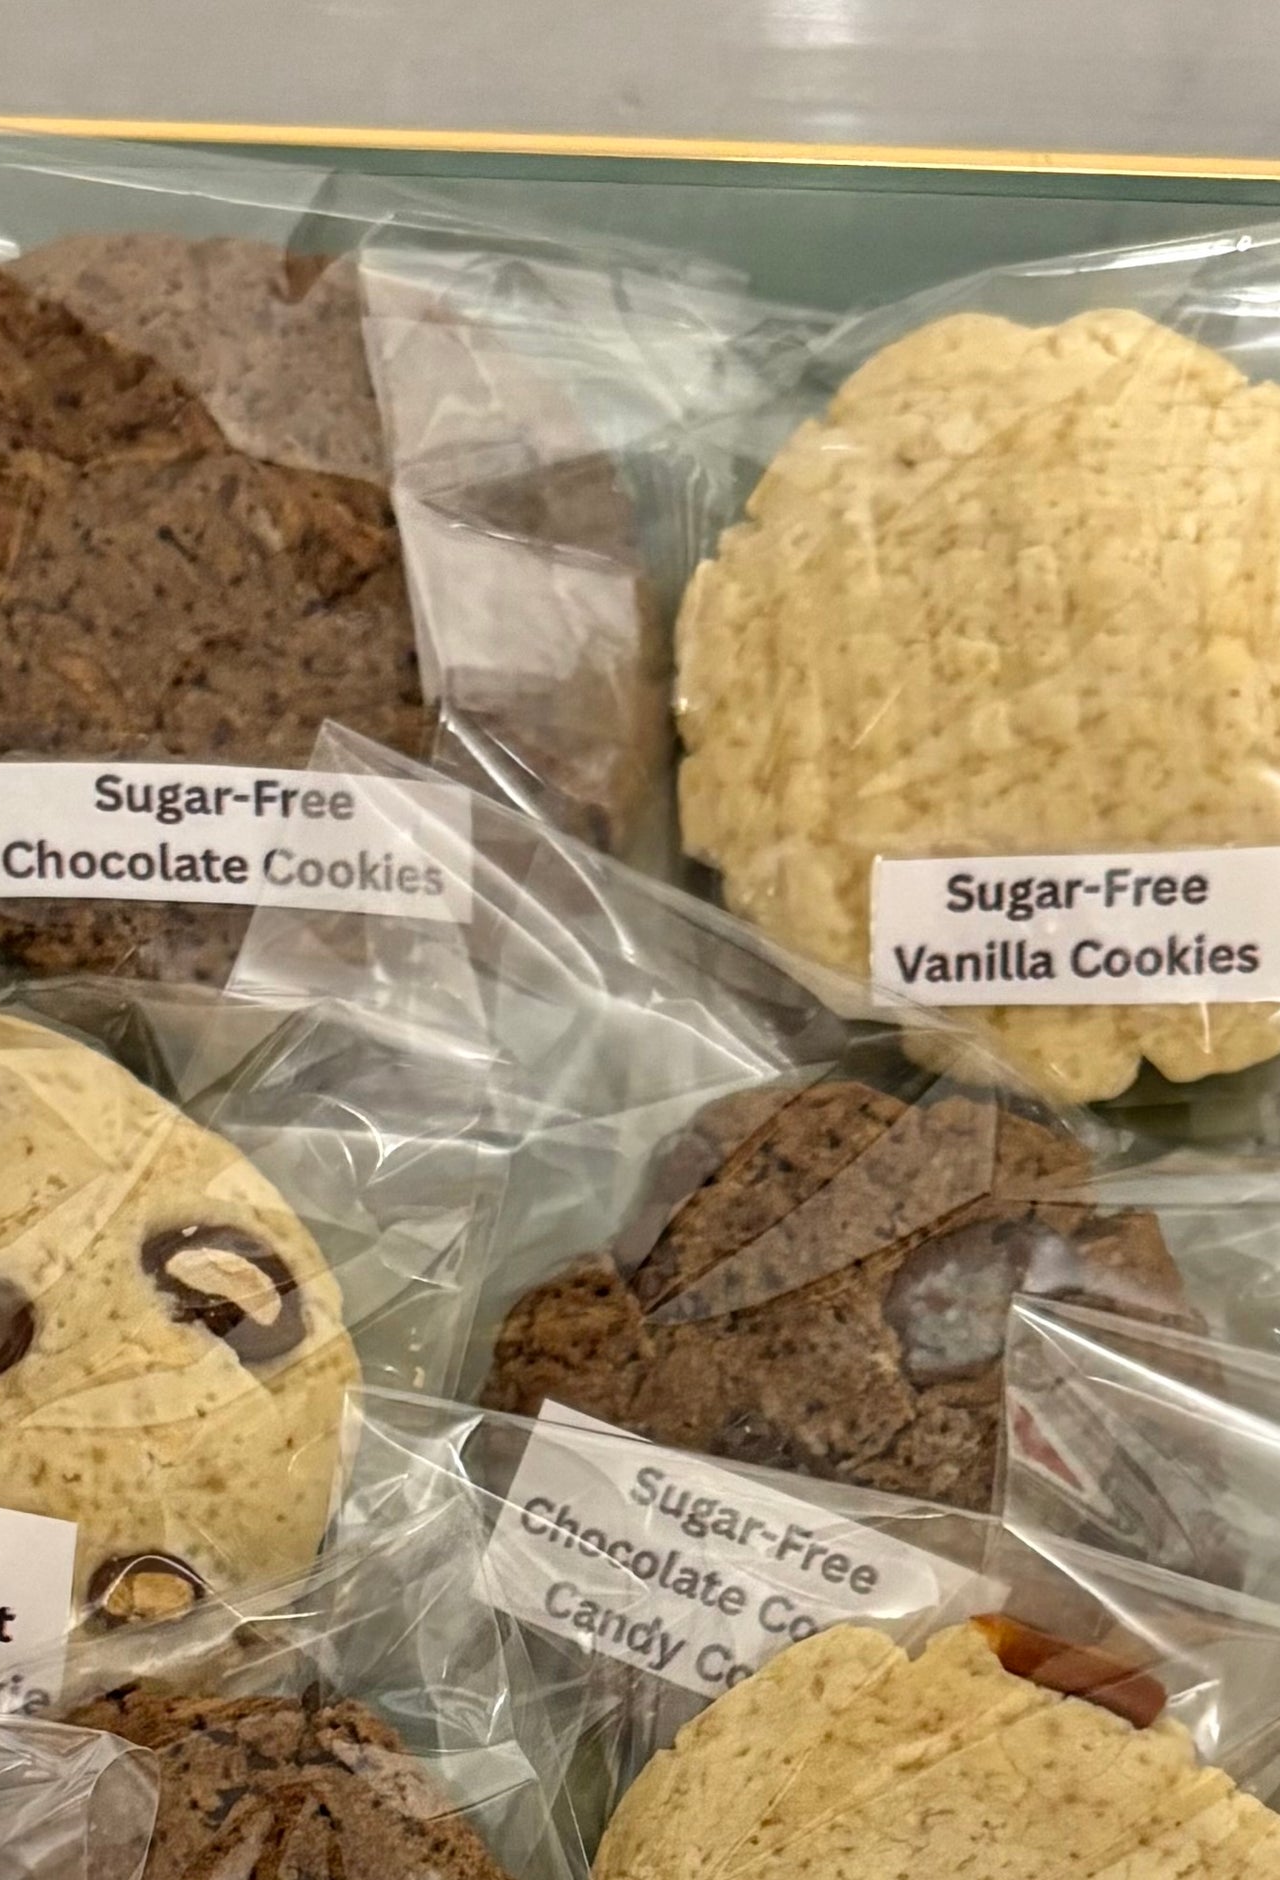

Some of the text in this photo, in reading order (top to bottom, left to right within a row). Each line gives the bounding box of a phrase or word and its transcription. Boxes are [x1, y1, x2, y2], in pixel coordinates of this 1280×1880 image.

[94, 774, 356, 824] Sugar-Free
[2, 840, 445, 895] Chocolate Cookies
[946, 869, 1208, 921] Sugar-Free
[894, 935, 1260, 983] Vanilla Cookies
[521, 1497, 747, 1616] Chocolate
[629, 1466, 879, 1595] Sugar-Free
[545, 1580, 686, 1671] Candy
